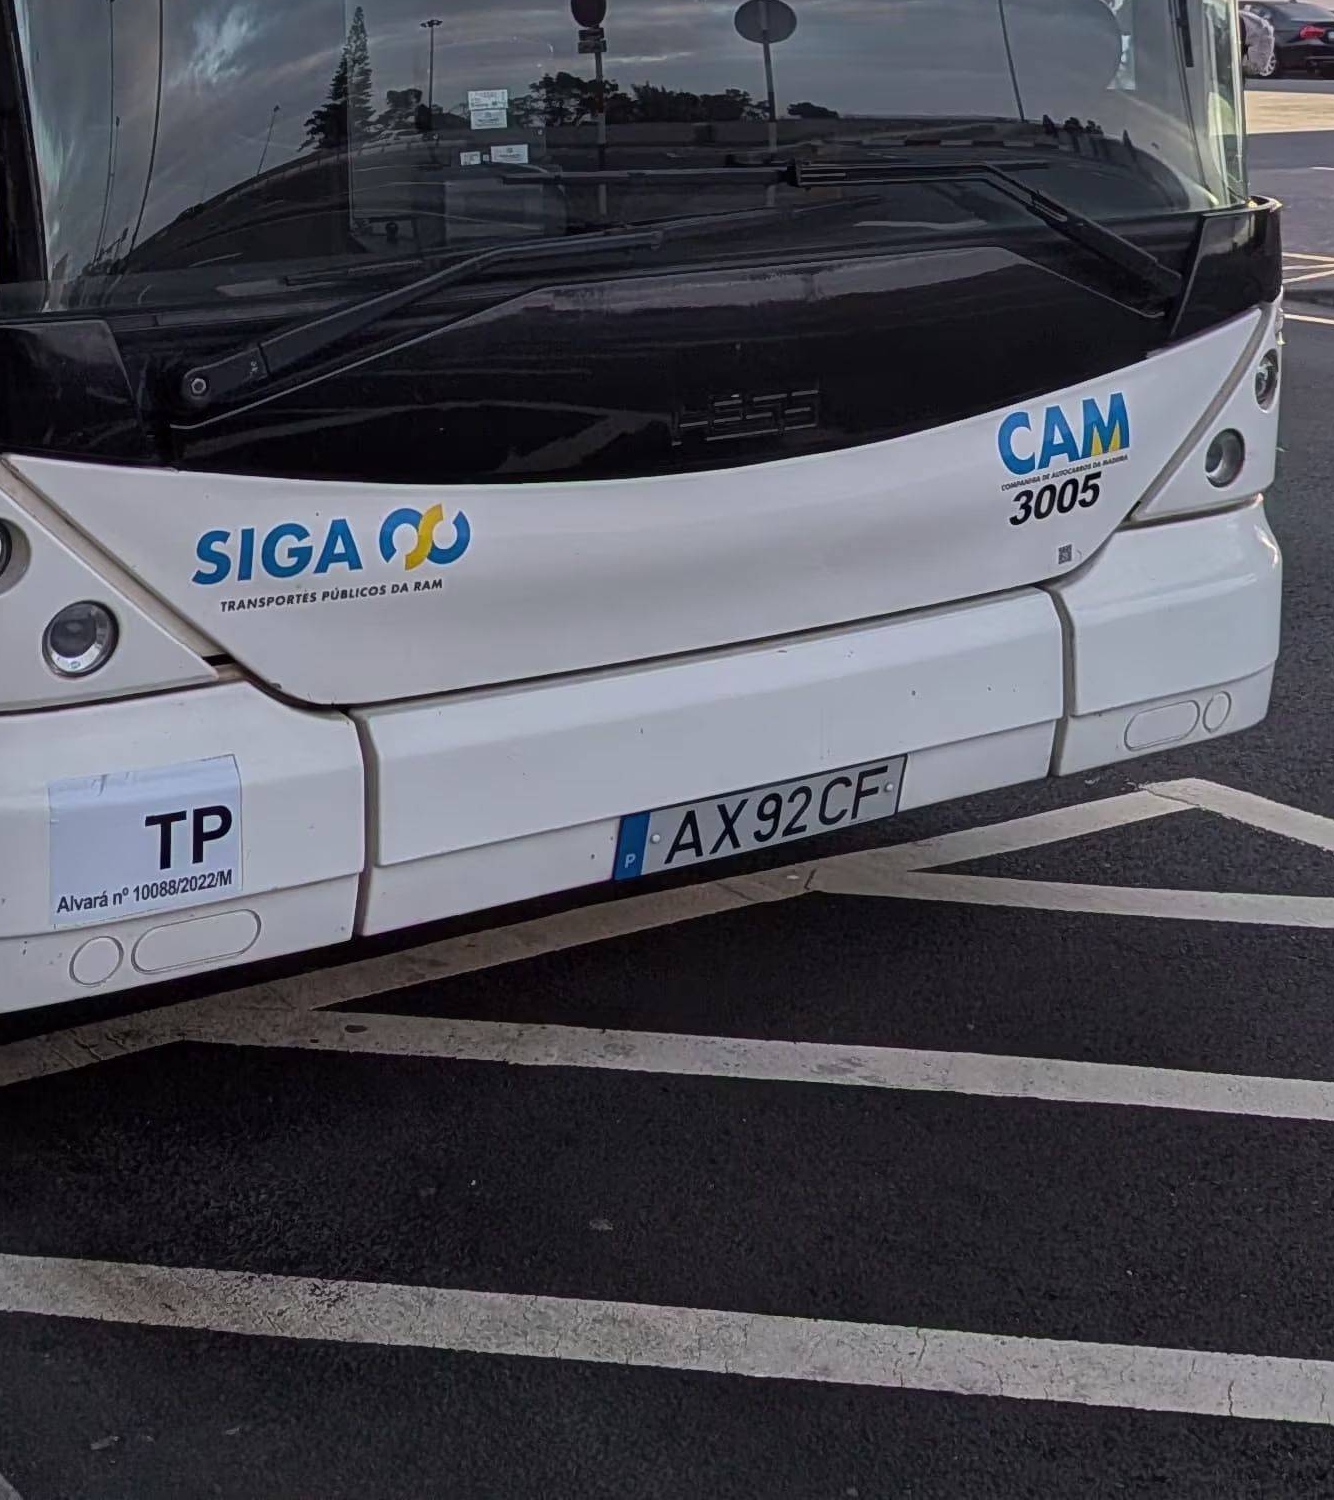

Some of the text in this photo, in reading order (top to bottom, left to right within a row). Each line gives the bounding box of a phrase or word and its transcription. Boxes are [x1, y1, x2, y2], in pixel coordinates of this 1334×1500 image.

[997, 392, 1131, 476] CAM
[1009, 471, 1103, 526] 3005
[191, 518, 364, 586] SIGA
[220, 578, 444, 613] TRANSPORTES PÚBLICOS DA RAM
[144, 804, 233, 870] TP
[623, 852, 637, 869] P
[56, 891, 109, 914] Alvará
[133, 869, 233, 902] 10088/2022/M
